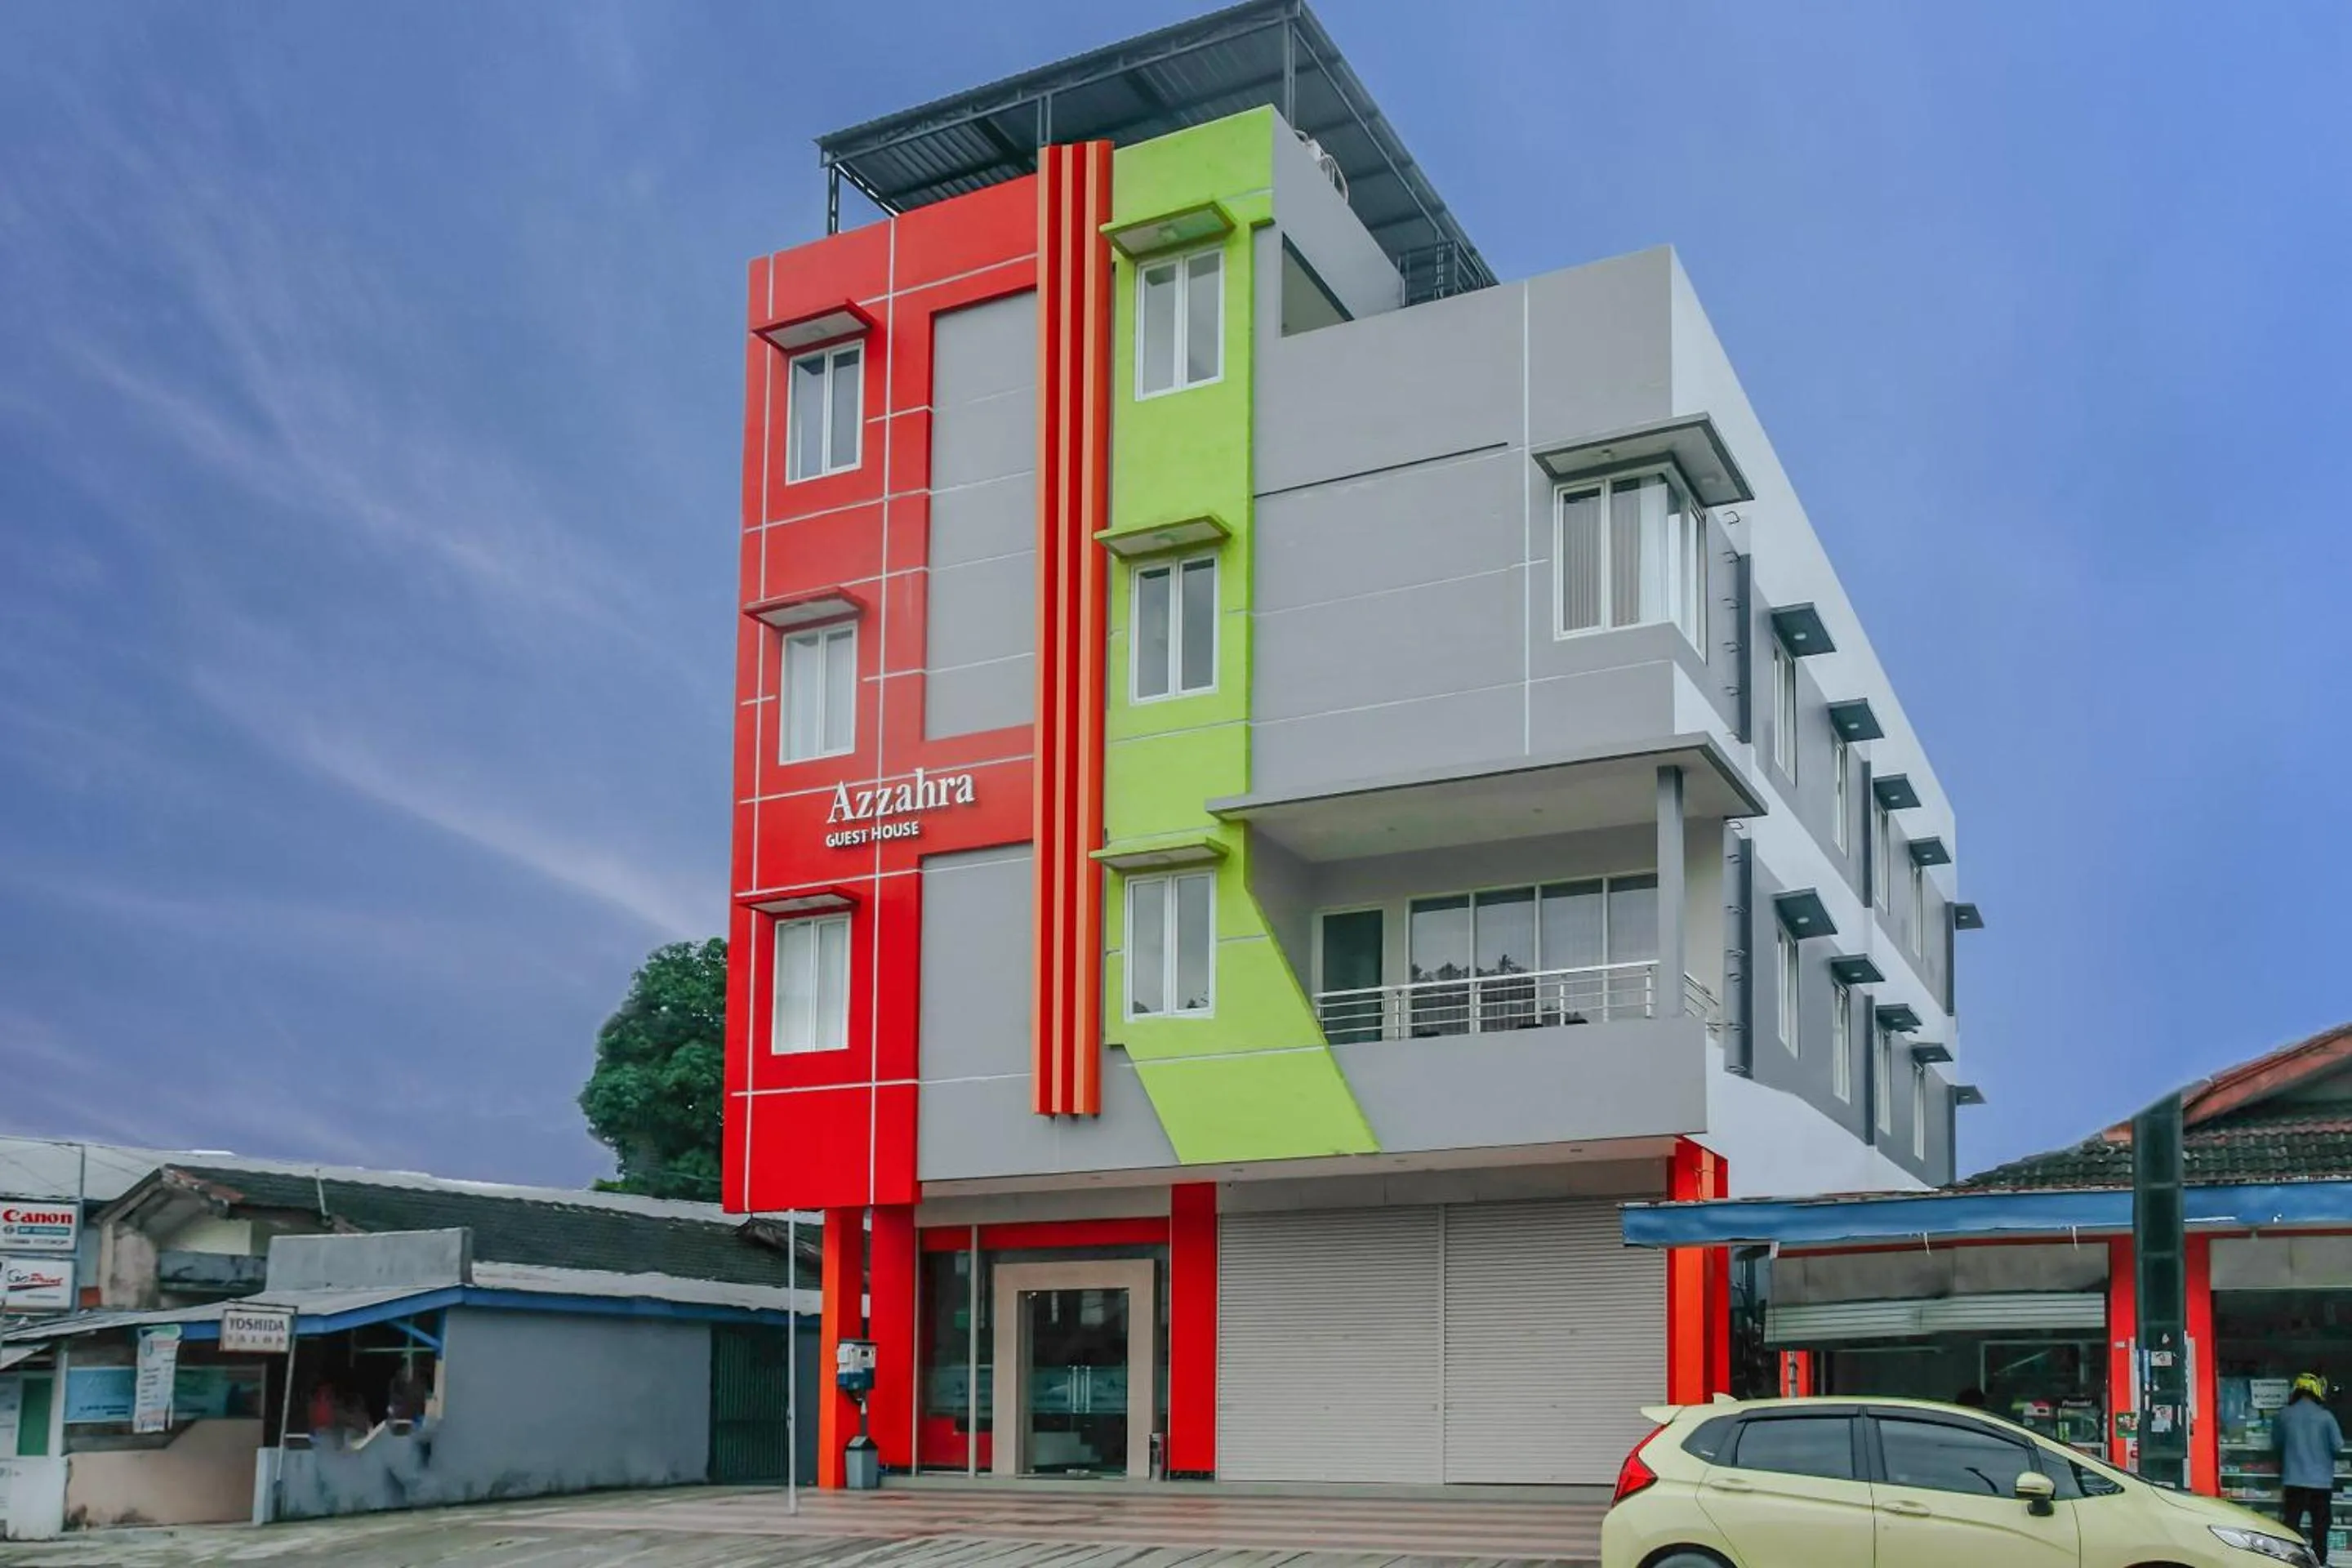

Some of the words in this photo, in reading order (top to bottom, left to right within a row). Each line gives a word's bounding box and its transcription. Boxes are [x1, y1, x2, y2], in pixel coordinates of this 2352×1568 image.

[826, 767, 974, 823] Azzahra
[826, 829, 868, 848] GUEST
[871, 821, 920, 841] HOUSE
[2, 1209, 74, 1224] Canon
